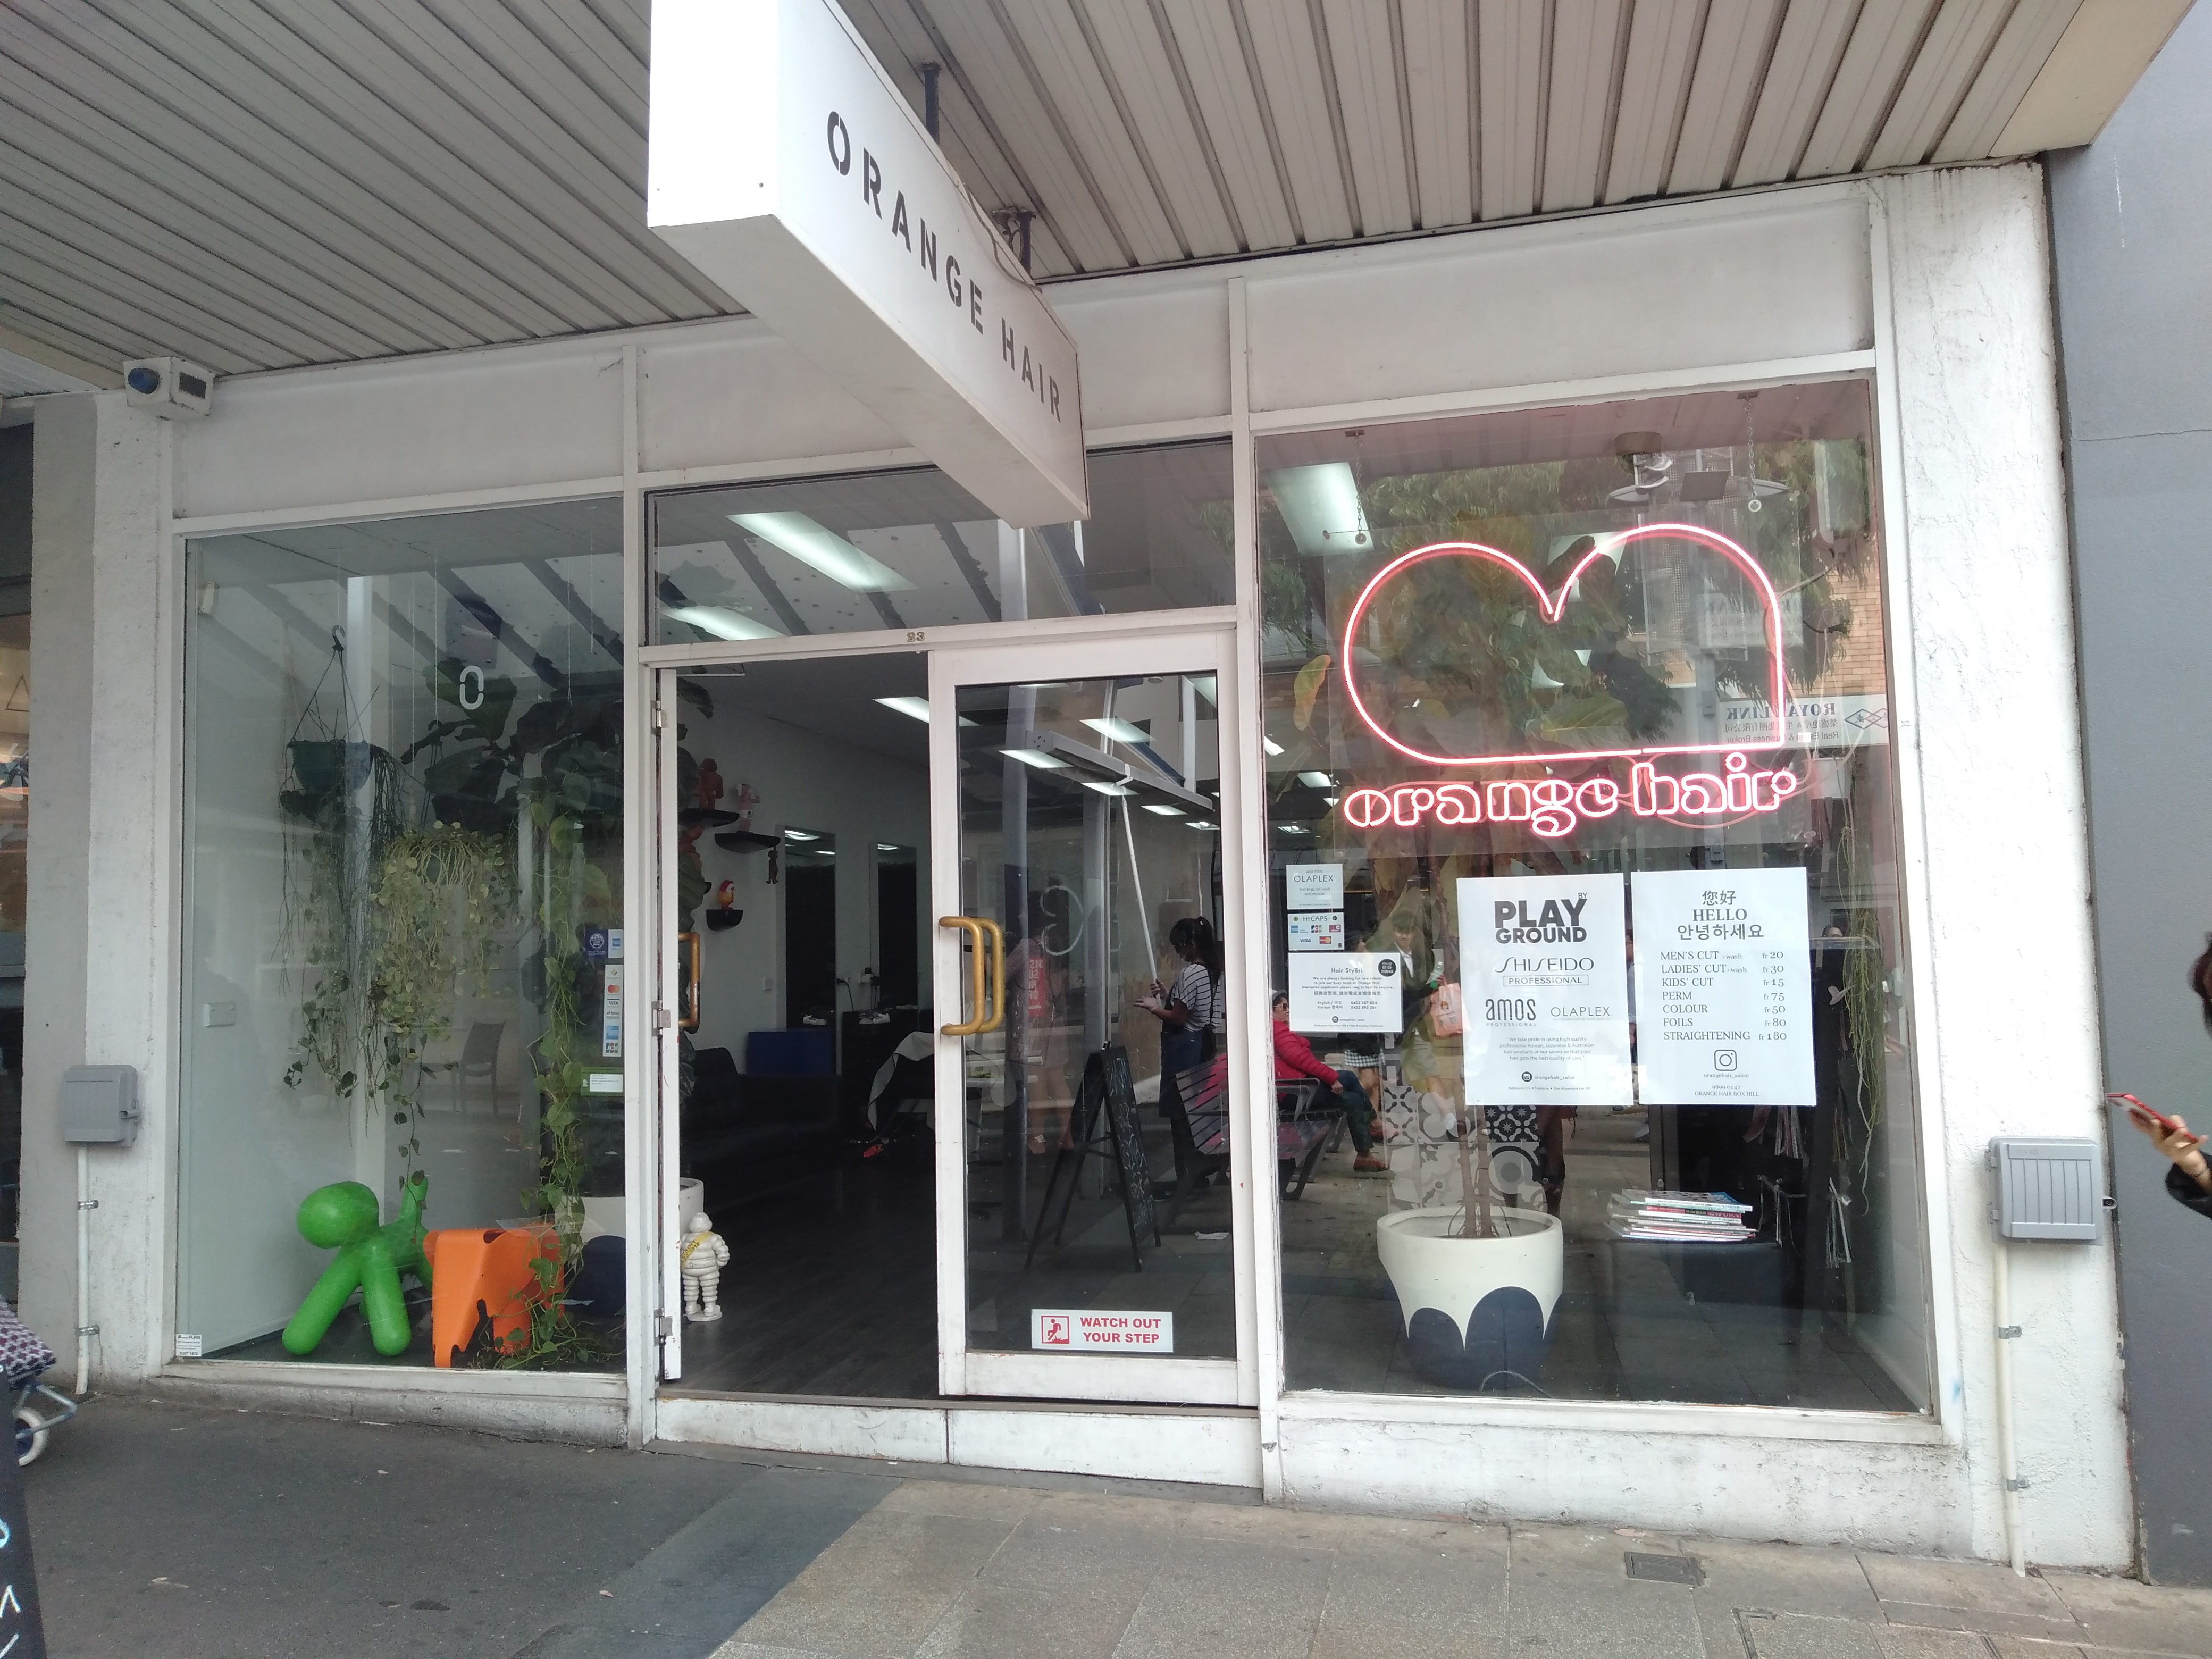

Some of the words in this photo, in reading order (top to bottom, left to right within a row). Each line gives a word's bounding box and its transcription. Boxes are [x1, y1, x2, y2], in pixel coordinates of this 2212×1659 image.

[827, 111, 983, 335] ORANGE
[1001, 317, 1061, 423] HAIR
[907, 631, 925, 642] 23
[1343, 778, 1619, 838] orange
[1632, 751, 1797, 817] hair
[1702, 890, 1736, 906] 您好
[1494, 899, 1588, 928] PLAY
[1692, 908, 1747, 921] HELLO
[1496, 927, 1587, 944] GROUND
[1677, 924, 1764, 940] 안녕하세요
[1697, 951, 1719, 960] CUT
[1494, 957, 1594, 973] SHISEIDO
[1705, 964, 1727, 973] CUT
[1771, 965, 1784, 974] 30
[1691, 977, 1714, 986] CUT
[1771, 978, 1784, 987] 15
[1662, 991, 1692, 1000] PERM
[1771, 993, 1784, 1001] 75
[1485, 998, 1536, 1021] amos
[1662, 1004, 1708, 1013] COLOUR
[1772, 1006, 1786, 1014] 50
[1663, 1018, 1694, 1027] FOILS
[1772, 1018, 1786, 1027] 80
[1663, 1031, 1750, 1040] STRAIGHTENING
[1766, 1031, 1787, 1040] 180
[1080, 1317, 1128, 1328] WATCH
[1133, 1318, 1161, 1328] OUT
[1083, 1332, 1120, 1343] YOUR
[1125, 1334, 1160, 1344] STEP
